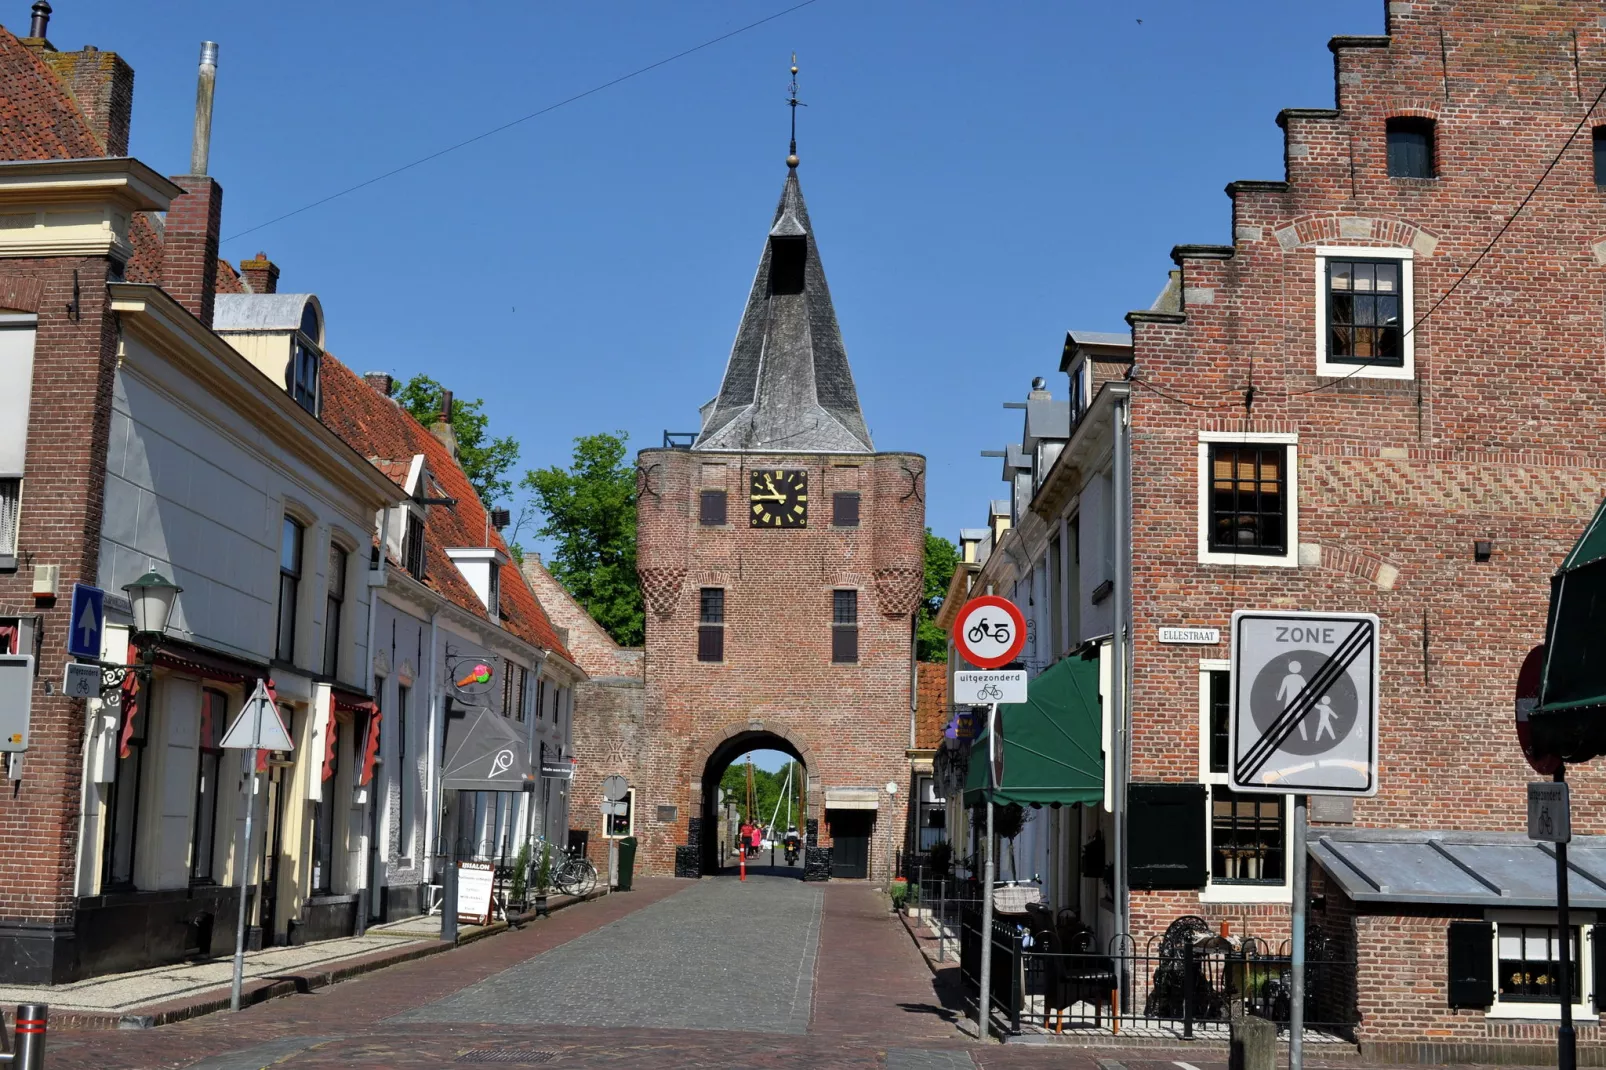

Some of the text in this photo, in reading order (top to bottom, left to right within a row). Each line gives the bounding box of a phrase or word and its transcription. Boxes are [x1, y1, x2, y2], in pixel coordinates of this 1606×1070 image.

[1163, 630, 1215, 641] ELLESTRAAT
[1275, 626, 1335, 644] ZONE
[960, 674, 1020, 684] uitgezonderd
